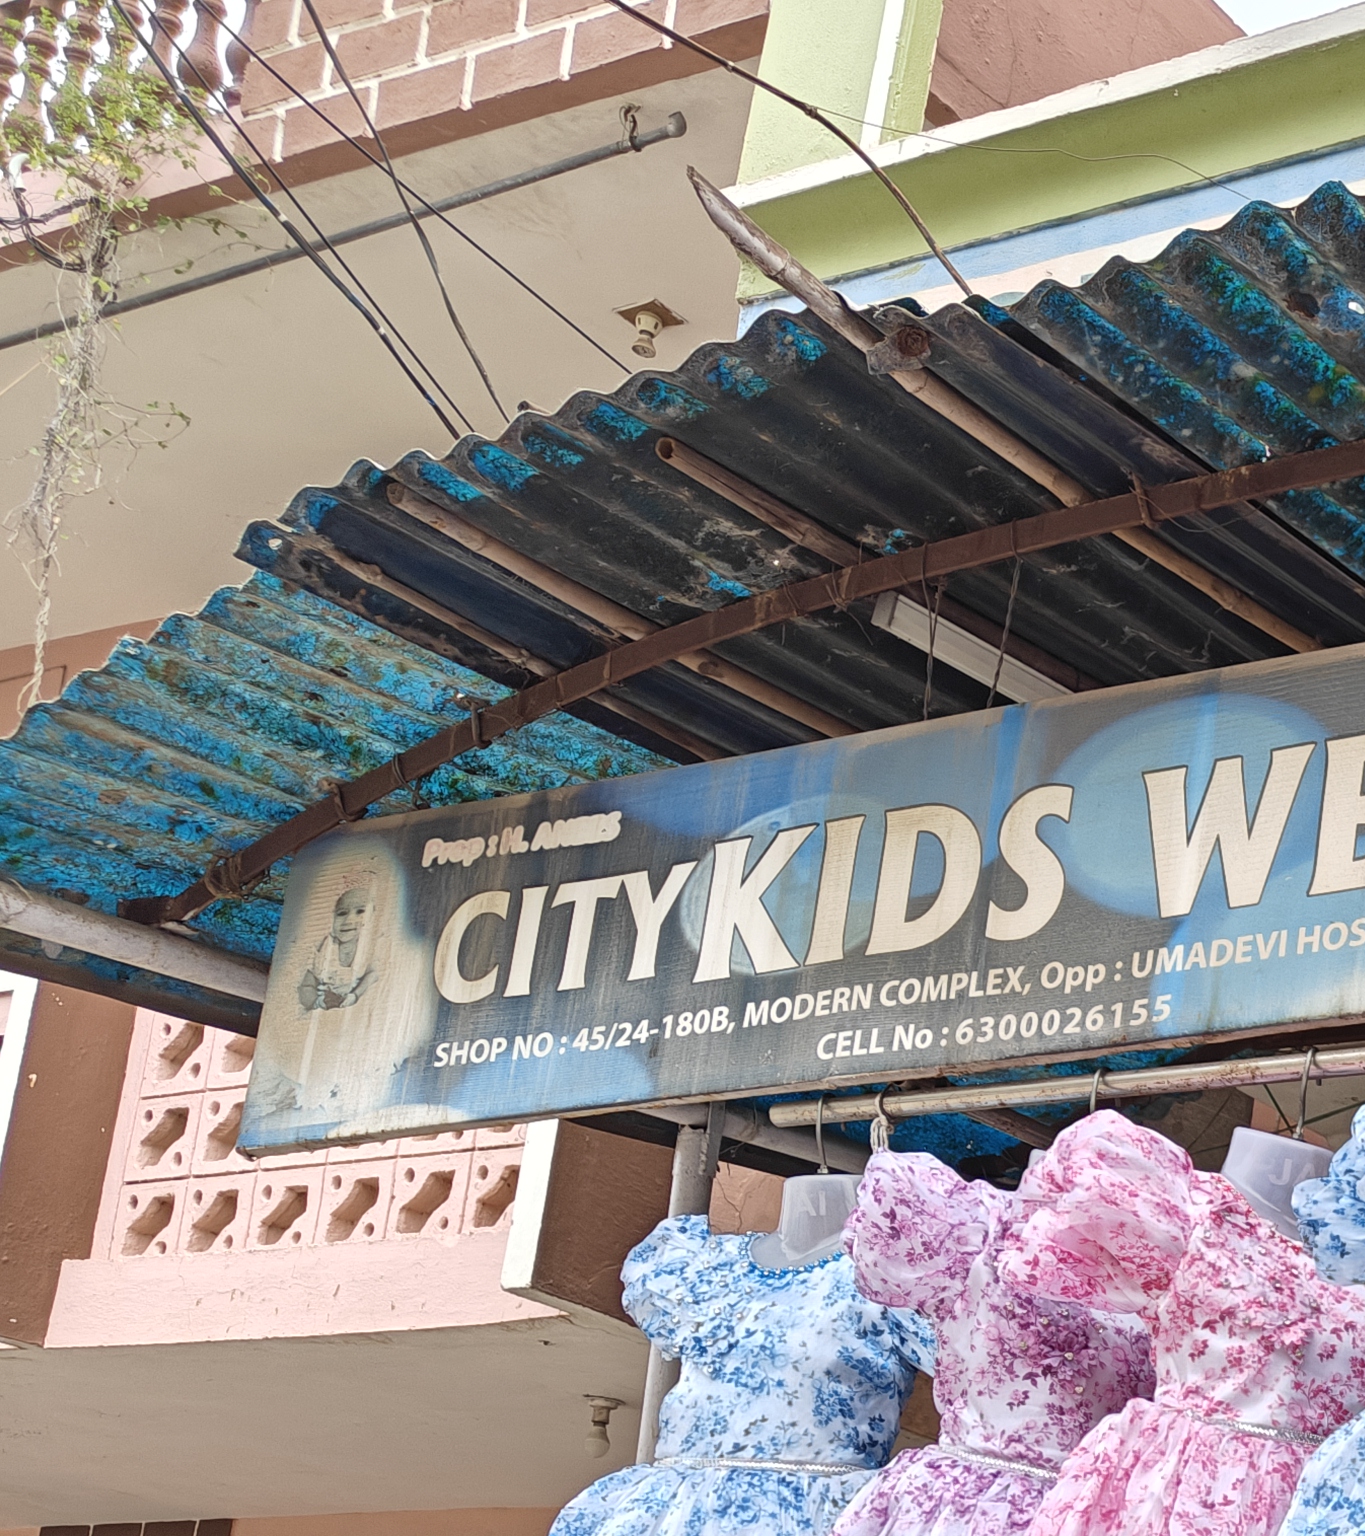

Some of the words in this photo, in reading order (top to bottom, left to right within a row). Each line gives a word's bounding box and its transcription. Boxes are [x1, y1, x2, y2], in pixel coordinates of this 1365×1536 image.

[434, 1037, 507, 1068] SHOP
[512, 1031, 554, 1061] NO
[572, 1006, 735, 1052] 45/24-180B,
[743, 982, 874, 1026] MODERN
[880, 965, 1031, 1007] COMPLEX,
[1041, 961, 1106, 993] Opp
[1130, 929, 1288, 979] UMADEVI
[816, 1028, 885, 1061] CELL
[892, 1024, 933, 1051] No
[955, 994, 1172, 1046] 6300026155
